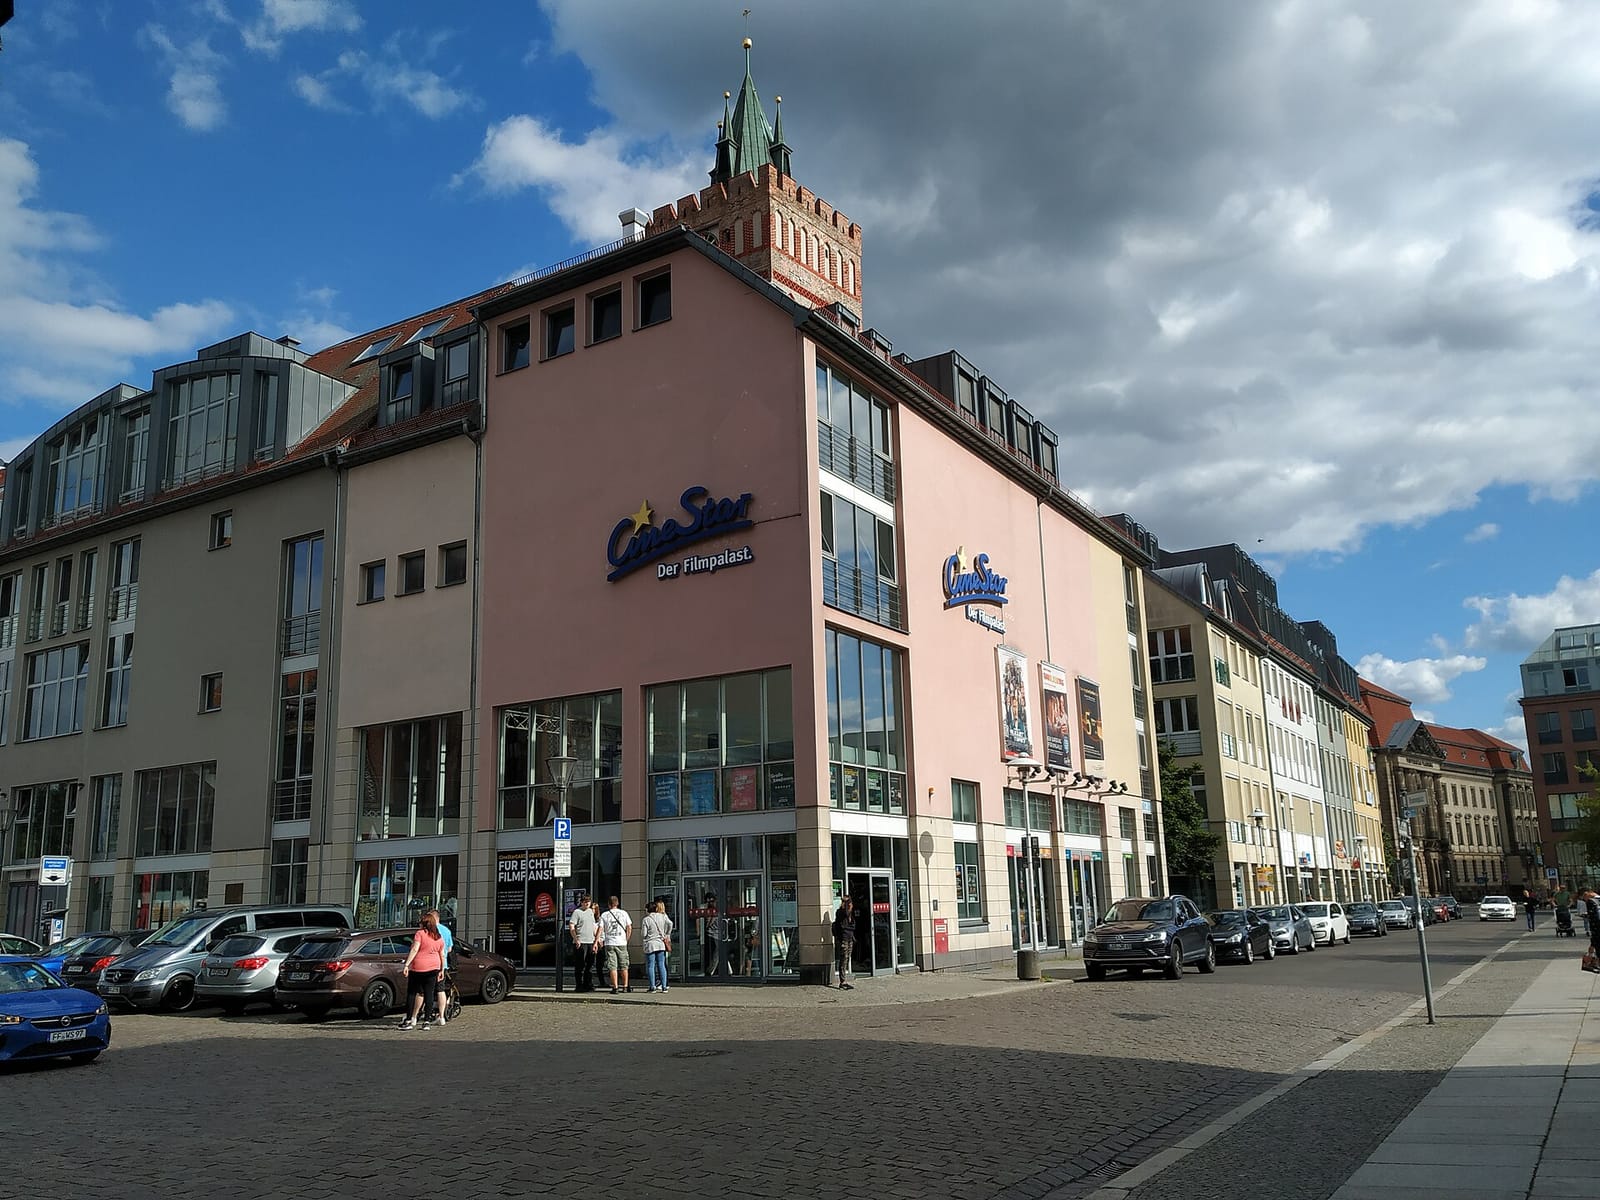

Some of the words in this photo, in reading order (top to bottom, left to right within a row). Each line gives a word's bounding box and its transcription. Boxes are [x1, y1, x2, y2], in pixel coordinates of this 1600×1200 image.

[607, 486, 753, 568] CineStar
[657, 563, 679, 578] Der
[683, 547, 753, 572] Filmpalast.
[943, 553, 1008, 598] CineStar
[967, 605, 979, 620] Der
[557, 821, 567, 838] P
[498, 860, 518, 871] FÜR
[520, 858, 554, 870] ECHTE
[498, 870, 553, 882] FILMFANS!
[55, 920, 62, 928] P
